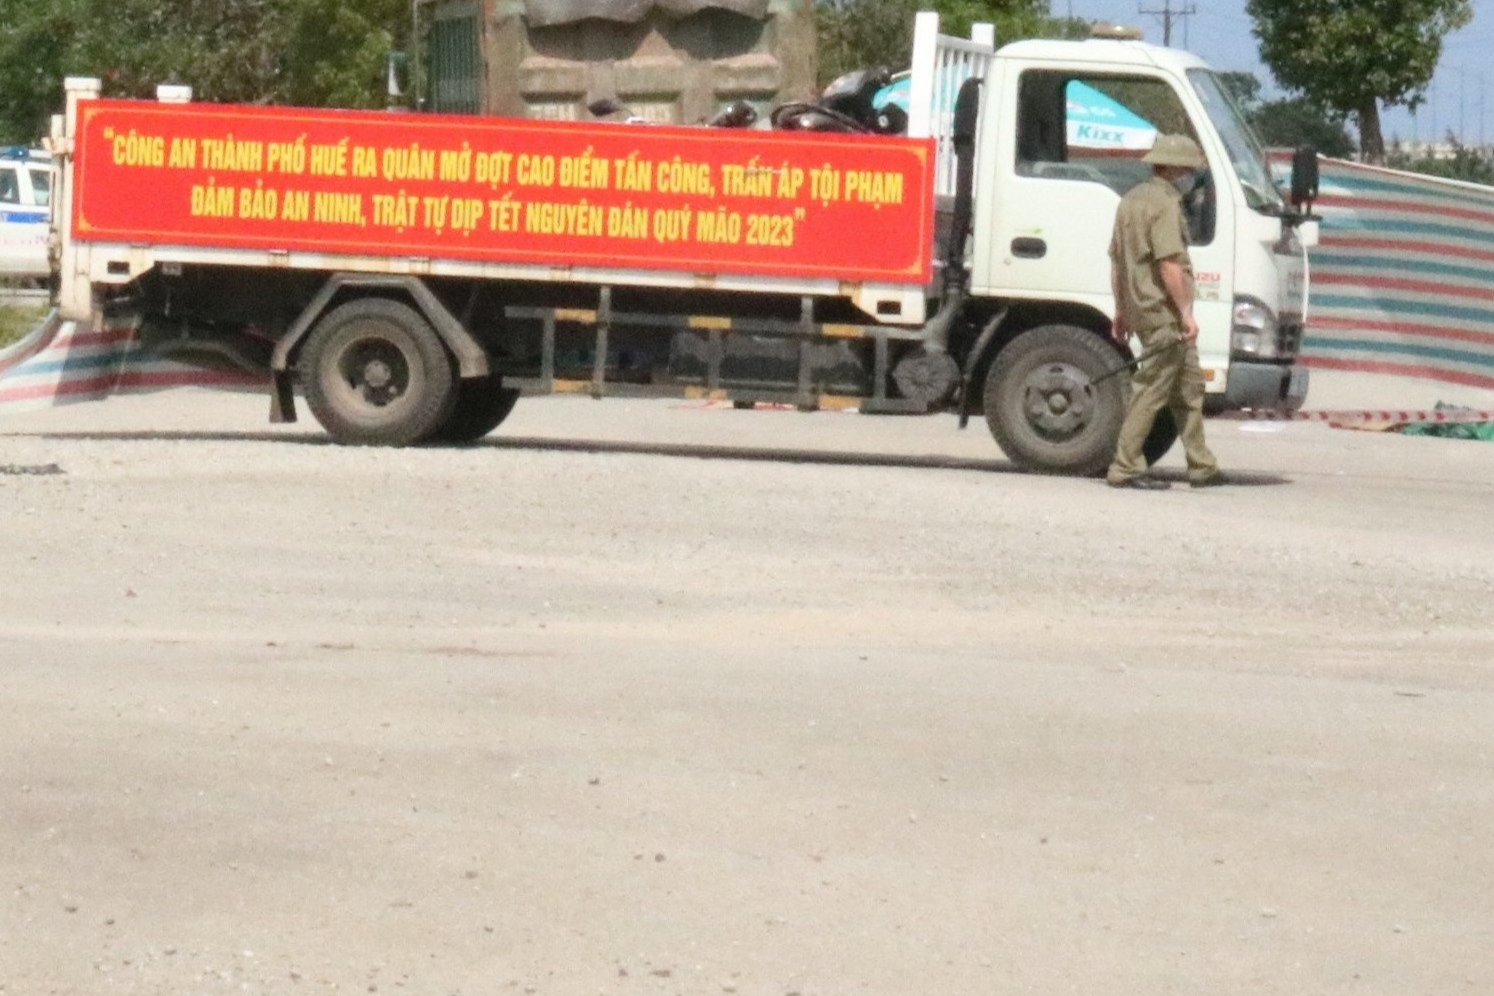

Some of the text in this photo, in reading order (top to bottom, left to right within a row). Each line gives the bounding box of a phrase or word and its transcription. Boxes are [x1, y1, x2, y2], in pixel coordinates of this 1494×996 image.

[1076, 123, 1125, 143] Kixx
[168, 137, 198, 169] AN
[201, 132, 264, 172] THÀNH
[266, 132, 309, 175] PHỐ
[309, 136, 350, 177] HUẾ
[351, 145, 379, 179] RA
[382, 141, 437, 182] QUÂN
[439, 140, 474, 183] MỞ
[474, 150, 514, 191] ĐỢT
[516, 152, 556, 188] CAO
[559, 144, 611, 190] ĐIỂM
[614, 149, 653, 192] TẤN
[656, 155, 717, 199] CÔNG,
[721, 155, 774, 198] TRẤN
[776, 160, 805, 199] ÁP
[809, 162, 841, 208] TỘI
[844, 170, 905, 211] PHẠM
[191, 175, 235, 217] ĐẢM
[238, 178, 279, 221] BẢO
[281, 190, 311, 222] AN
[313, 191, 367, 228] NINH,
[372, 188, 420, 234] TRẬT
[423, 194, 450, 236] TỰ
[450, 197, 485, 237] DỊP
[488, 190, 522, 233] TẾT
[525, 197, 605, 237] NGUYÊN
[607, 201, 650, 240] ĐÁN
[653, 203, 692, 244] QUÝ
[696, 205, 742, 245] MÃO
